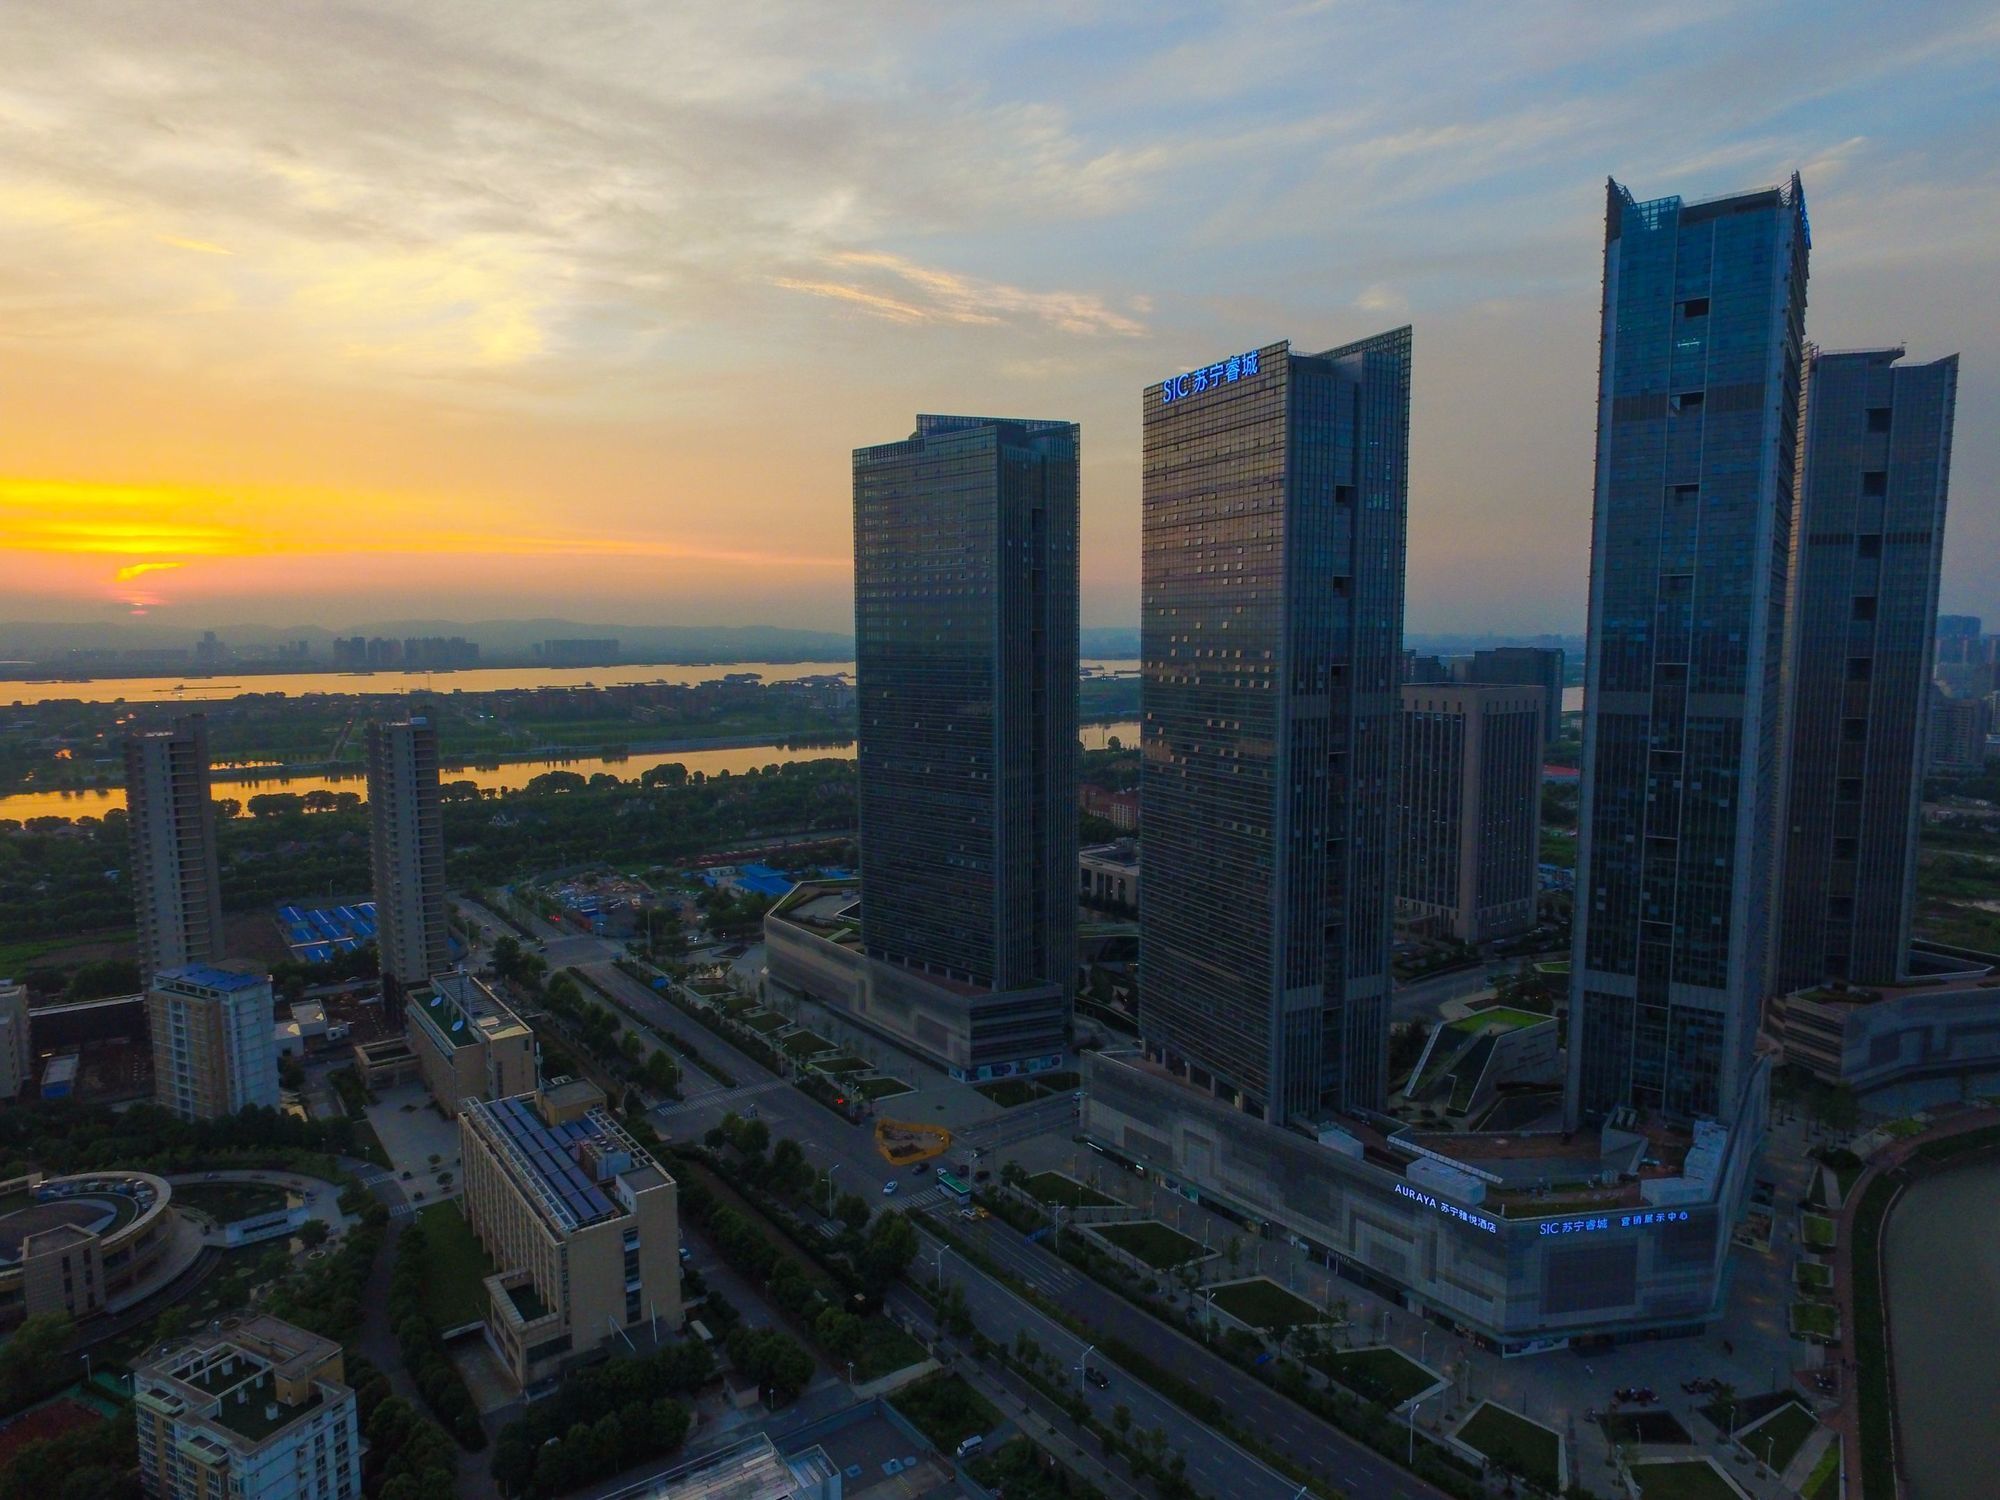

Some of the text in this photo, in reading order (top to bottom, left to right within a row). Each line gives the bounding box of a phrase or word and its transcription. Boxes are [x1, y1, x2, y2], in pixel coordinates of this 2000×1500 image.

[1163, 351, 1259, 403] SIC 苏宁睿城
[1394, 1184, 1497, 1234] AURAYA 苏宁雅悦酒店
[1539, 1222, 1559, 1236] SIC
[1562, 1217, 1609, 1234] 苏宁睿城
